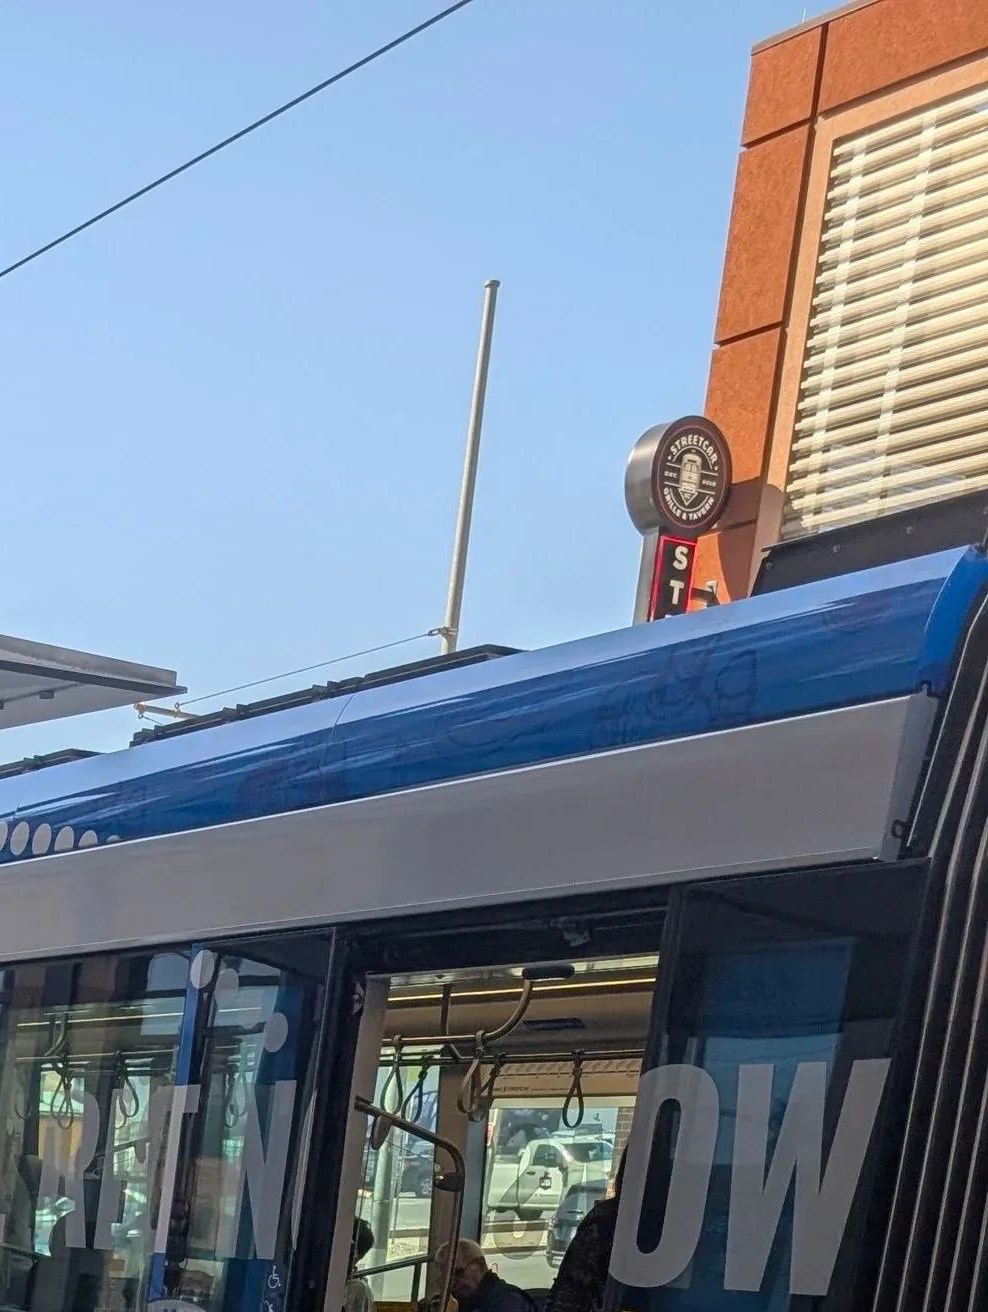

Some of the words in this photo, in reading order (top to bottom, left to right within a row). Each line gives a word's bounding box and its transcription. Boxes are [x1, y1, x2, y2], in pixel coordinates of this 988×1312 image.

[670, 435, 718, 464] STREETCAR
[663, 487, 681, 517] GRILLE
[682, 512, 687, 520] &
[688, 497, 714, 520] TAVERN
[668, 545, 689, 610] ST
